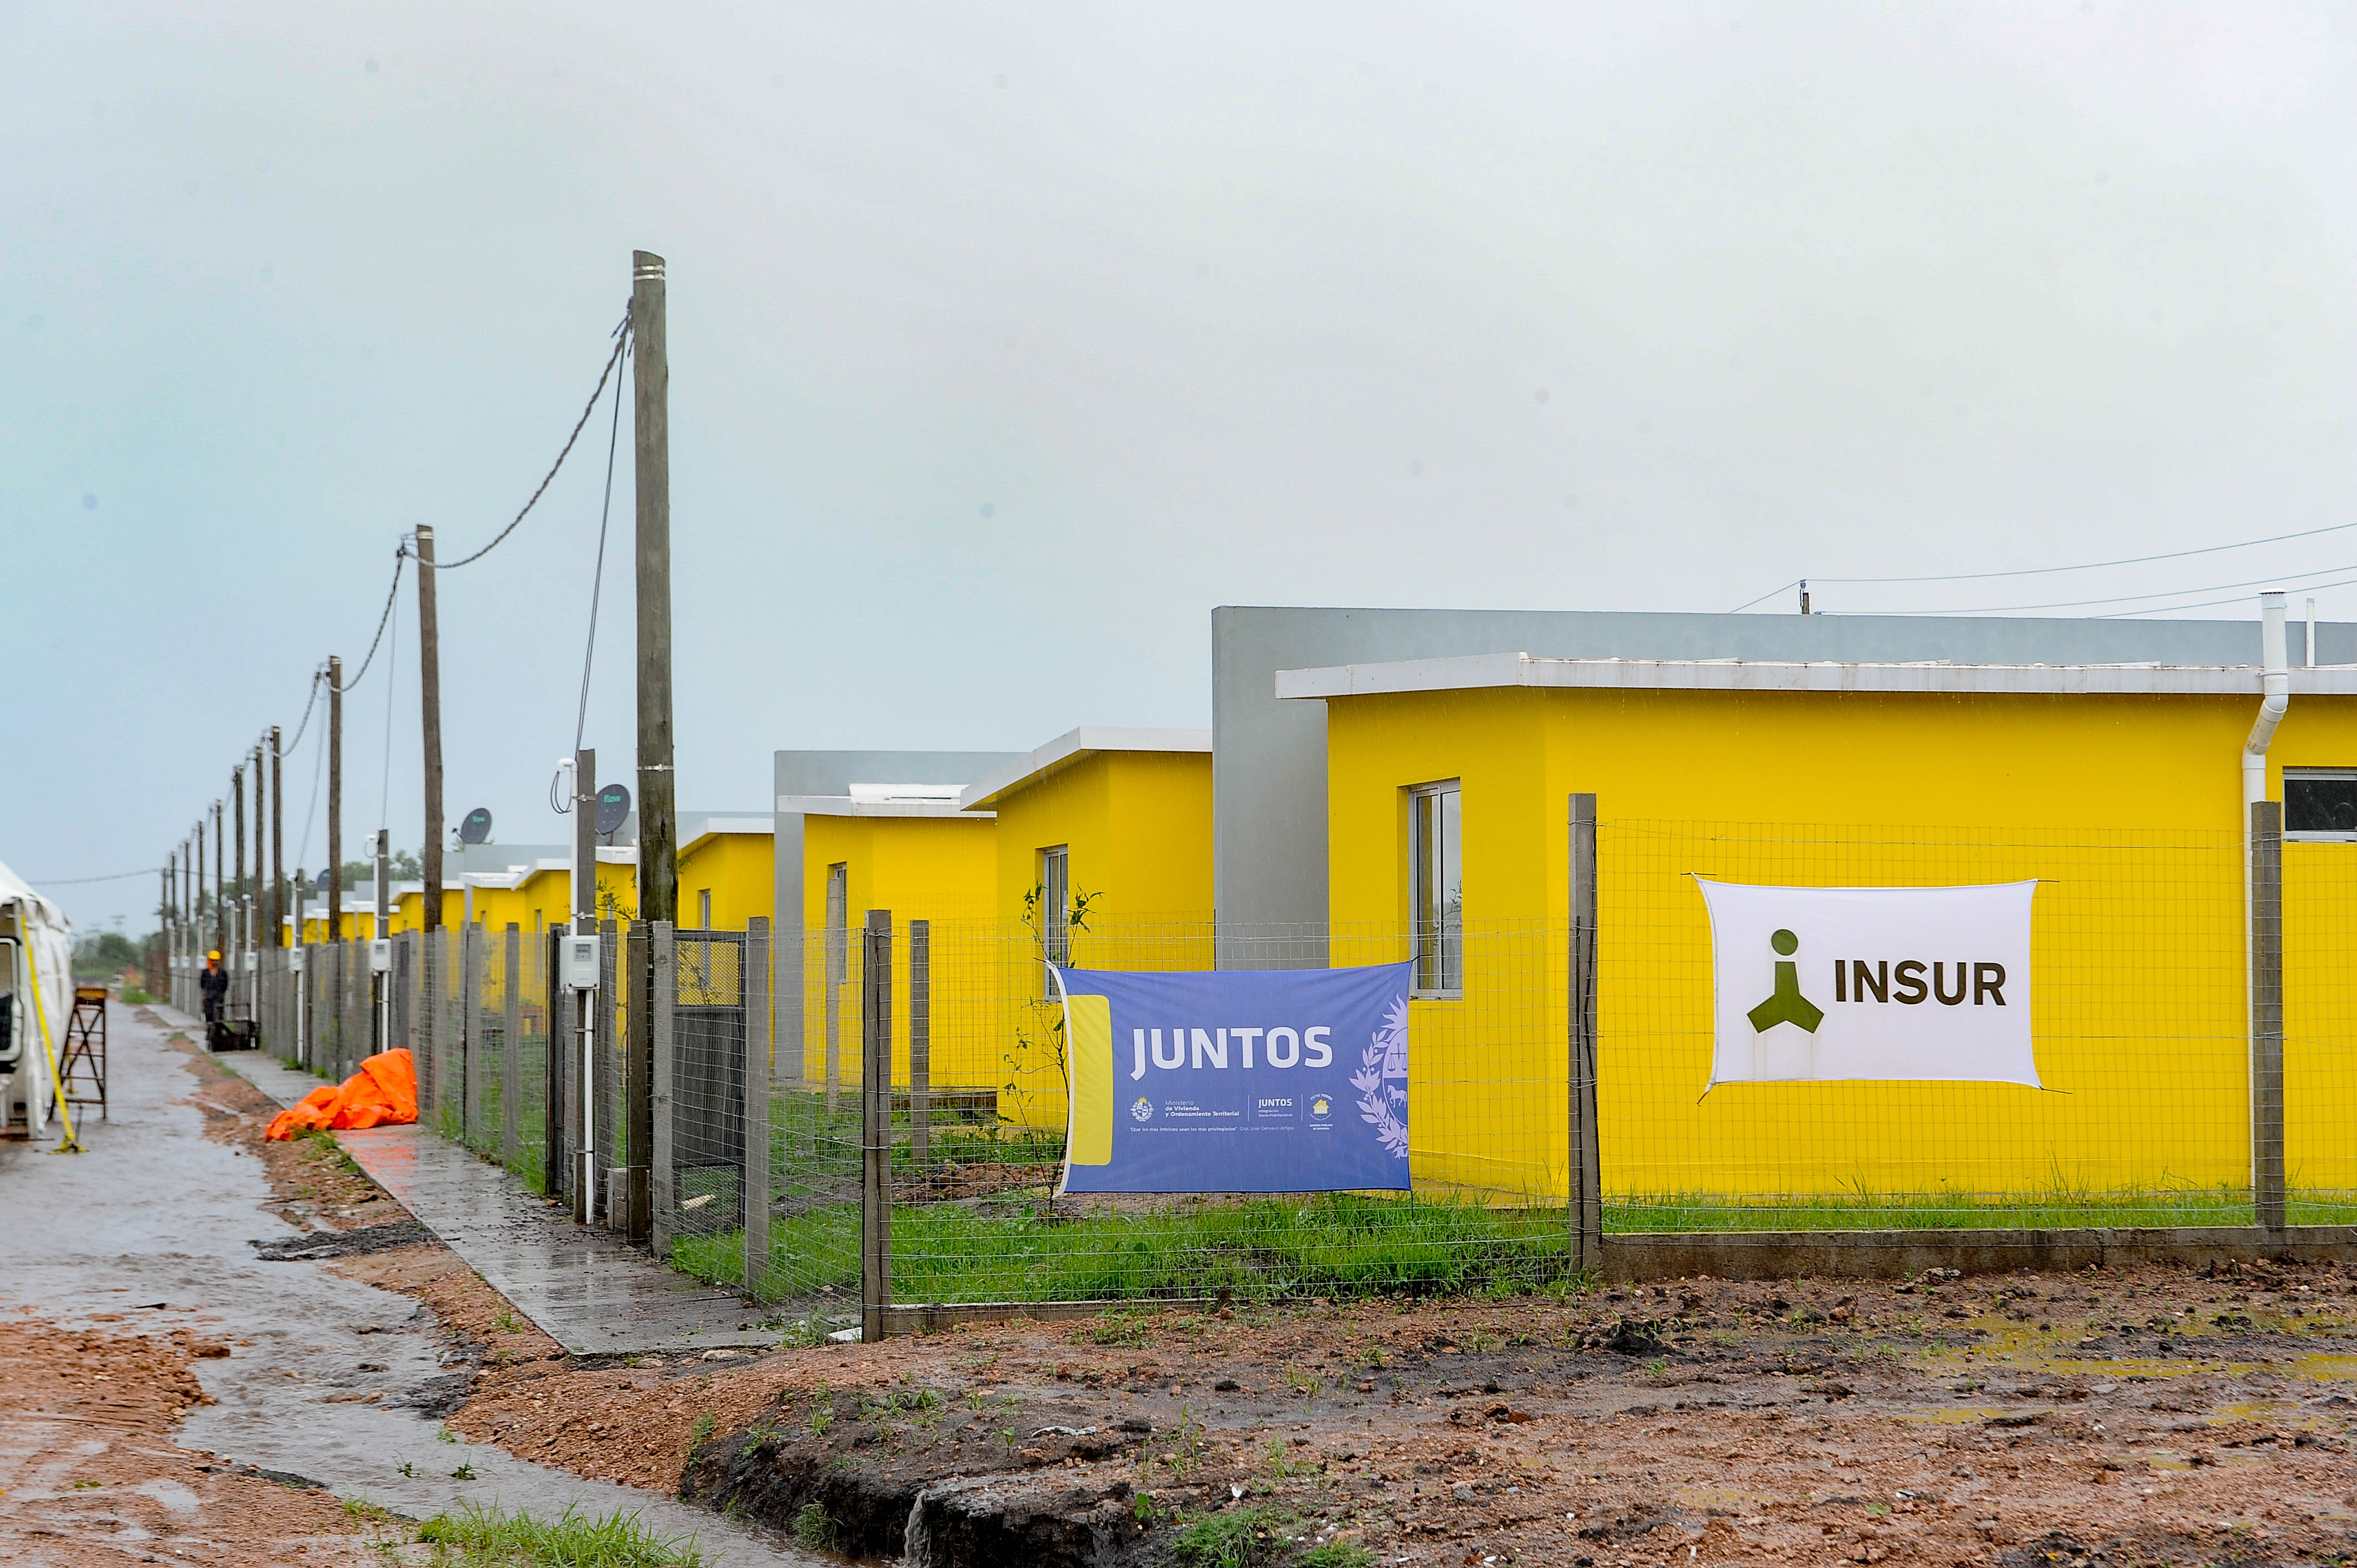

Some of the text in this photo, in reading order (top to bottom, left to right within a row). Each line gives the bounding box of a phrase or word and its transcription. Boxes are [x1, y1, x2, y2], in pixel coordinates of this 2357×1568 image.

[1835, 960, 2006, 1006] INSUR
[1130, 1025, 1333, 1081] JUNTOS
[1258, 1098, 1293, 1108] JUNTOS
